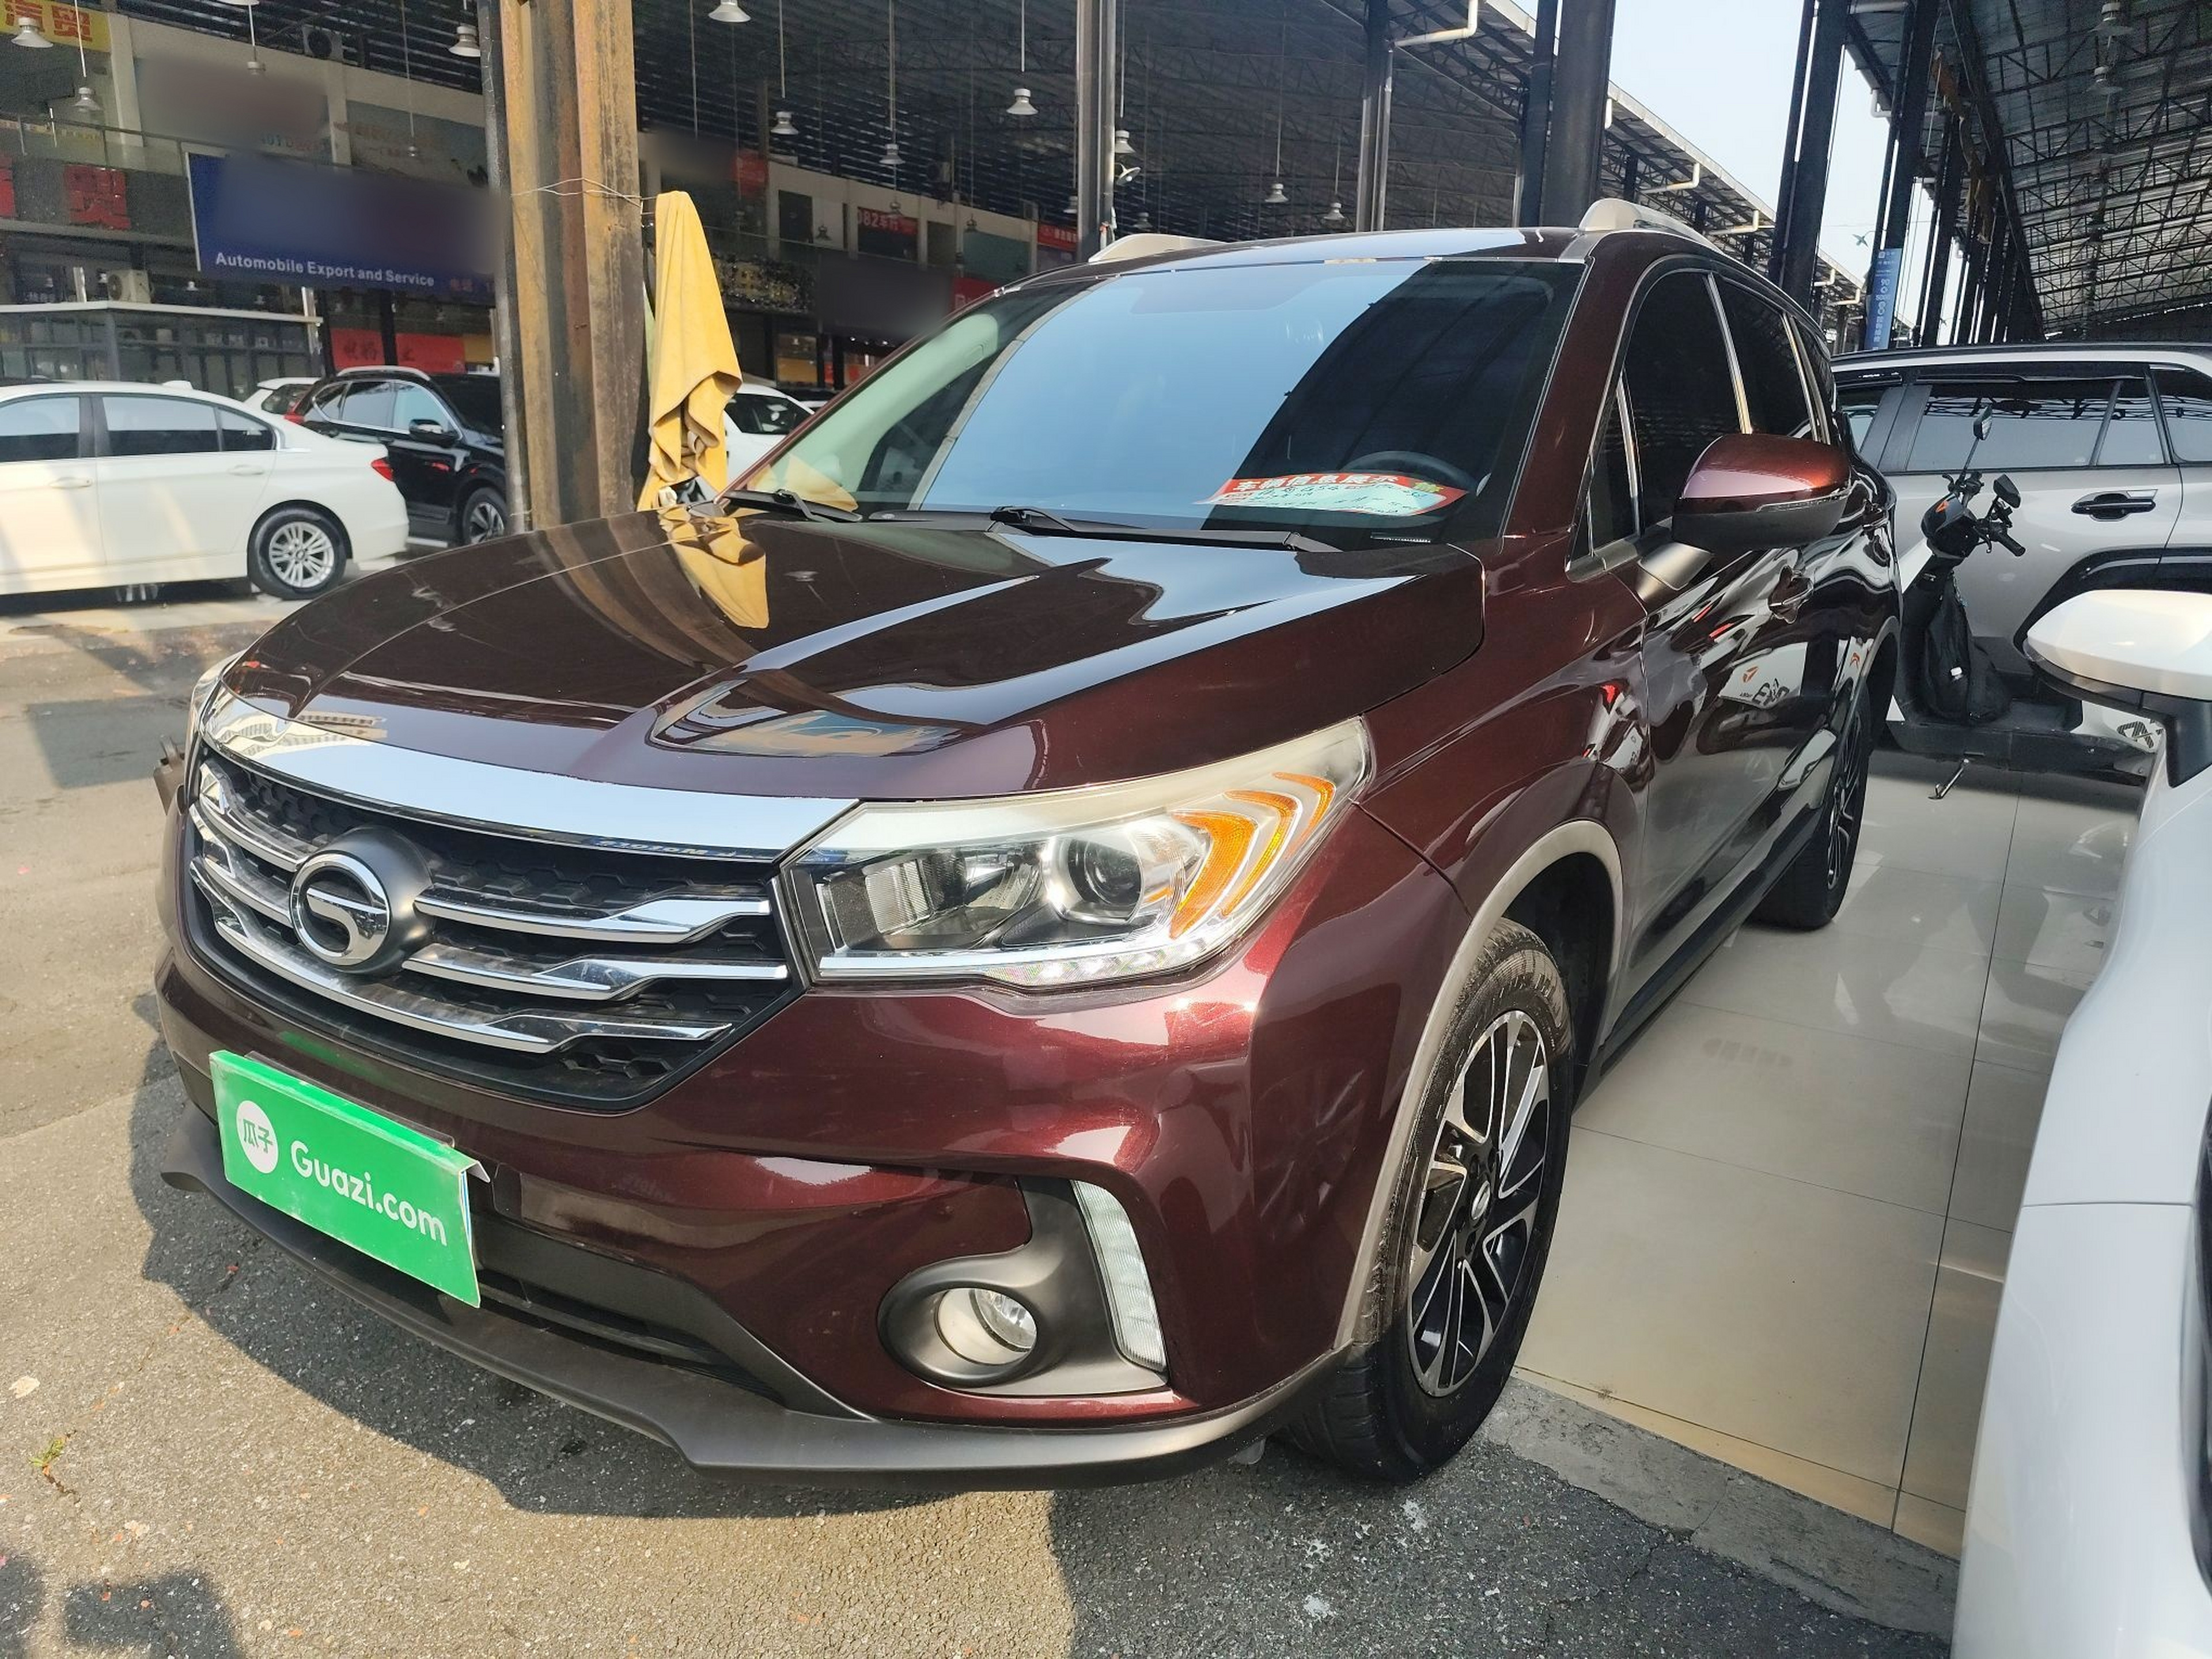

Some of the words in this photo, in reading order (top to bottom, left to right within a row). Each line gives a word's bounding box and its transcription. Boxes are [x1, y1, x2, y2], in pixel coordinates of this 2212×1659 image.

[216, 252, 304, 274] Automobile
[307, 261, 355, 279] Export
[358, 268, 382, 281] and
[385, 270, 434, 287] Service
[243, 1118, 274, 1154] 瓜子
[291, 1140, 447, 1247] Guazi.com
